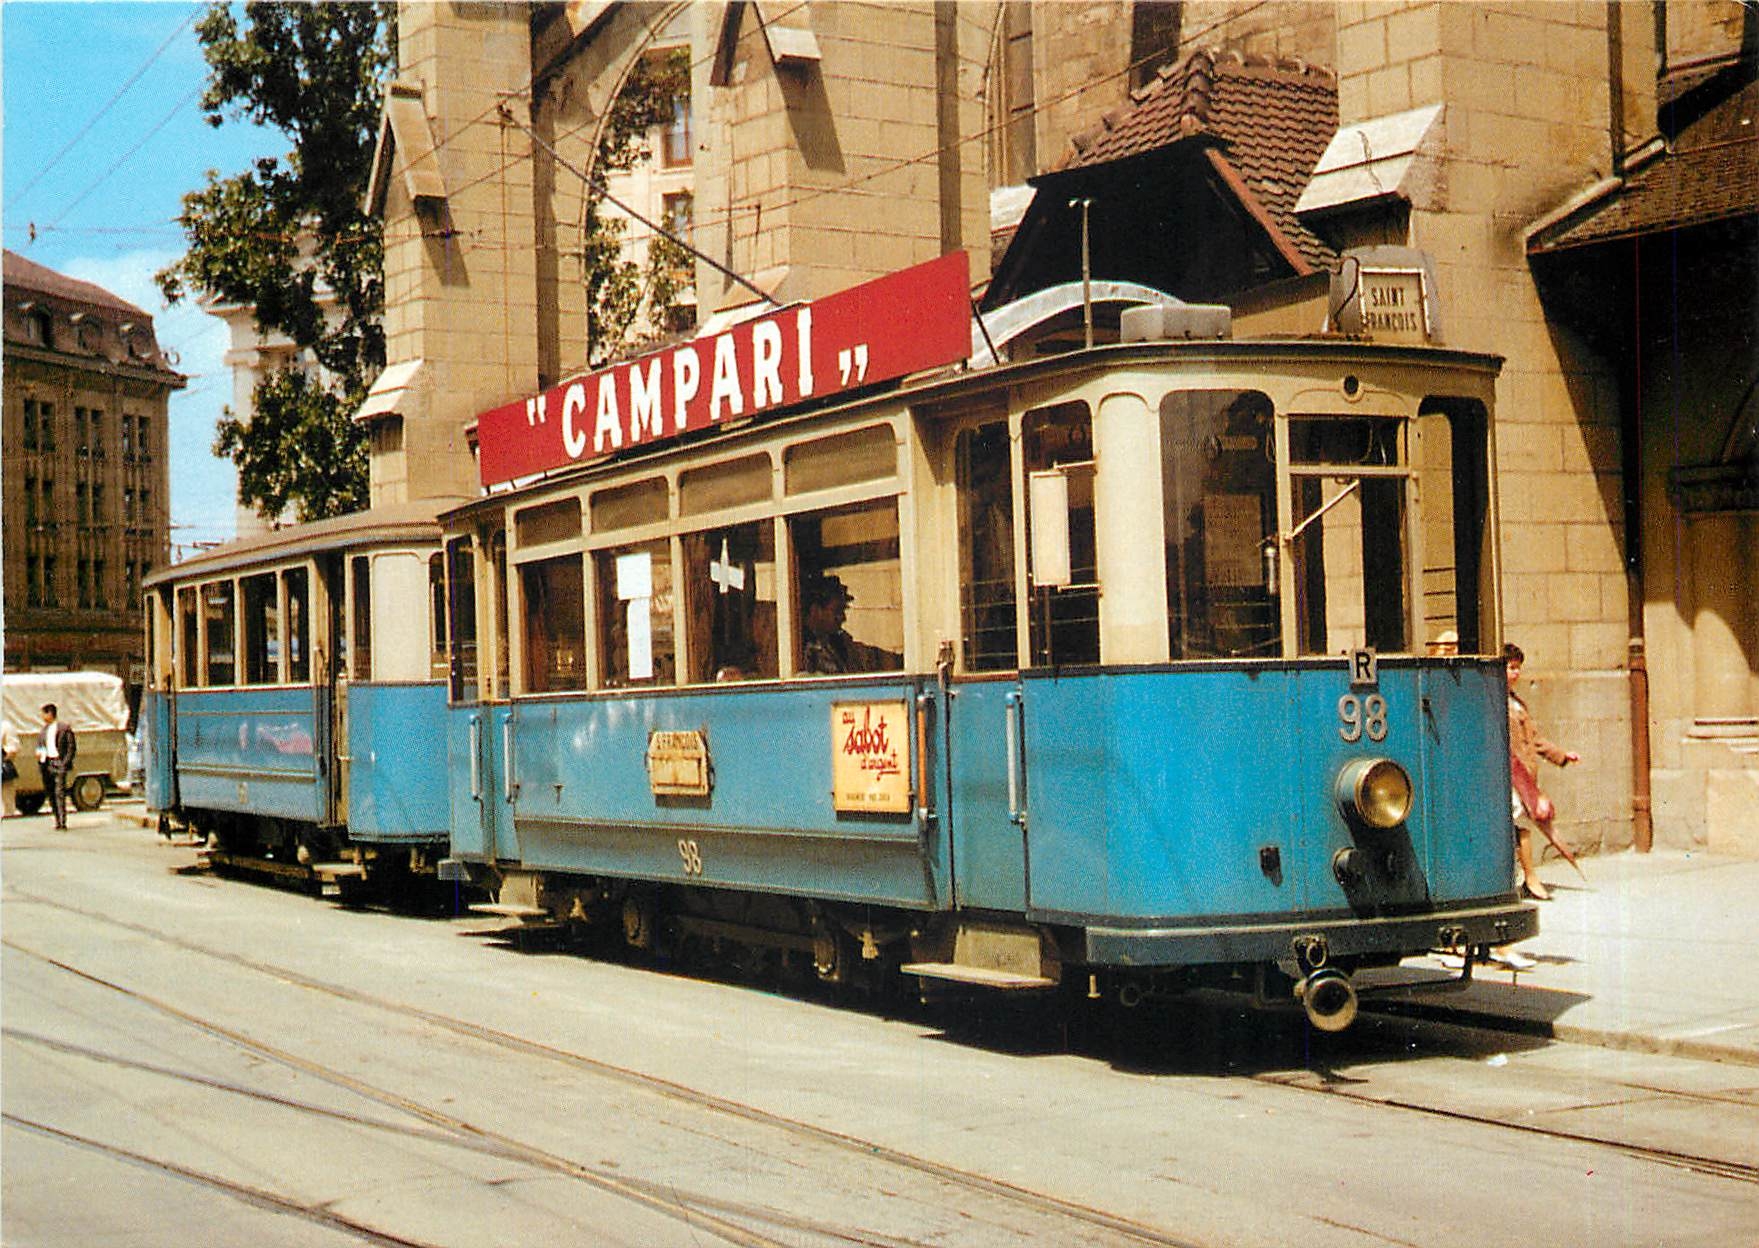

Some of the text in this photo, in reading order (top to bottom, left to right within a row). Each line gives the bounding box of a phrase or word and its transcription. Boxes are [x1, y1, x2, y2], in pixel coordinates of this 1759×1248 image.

[1371, 287, 1405, 307] SAINT
[1355, 652, 1371, 679] R
[1338, 694, 1388, 742] 98
[678, 840, 702, 874] 98
